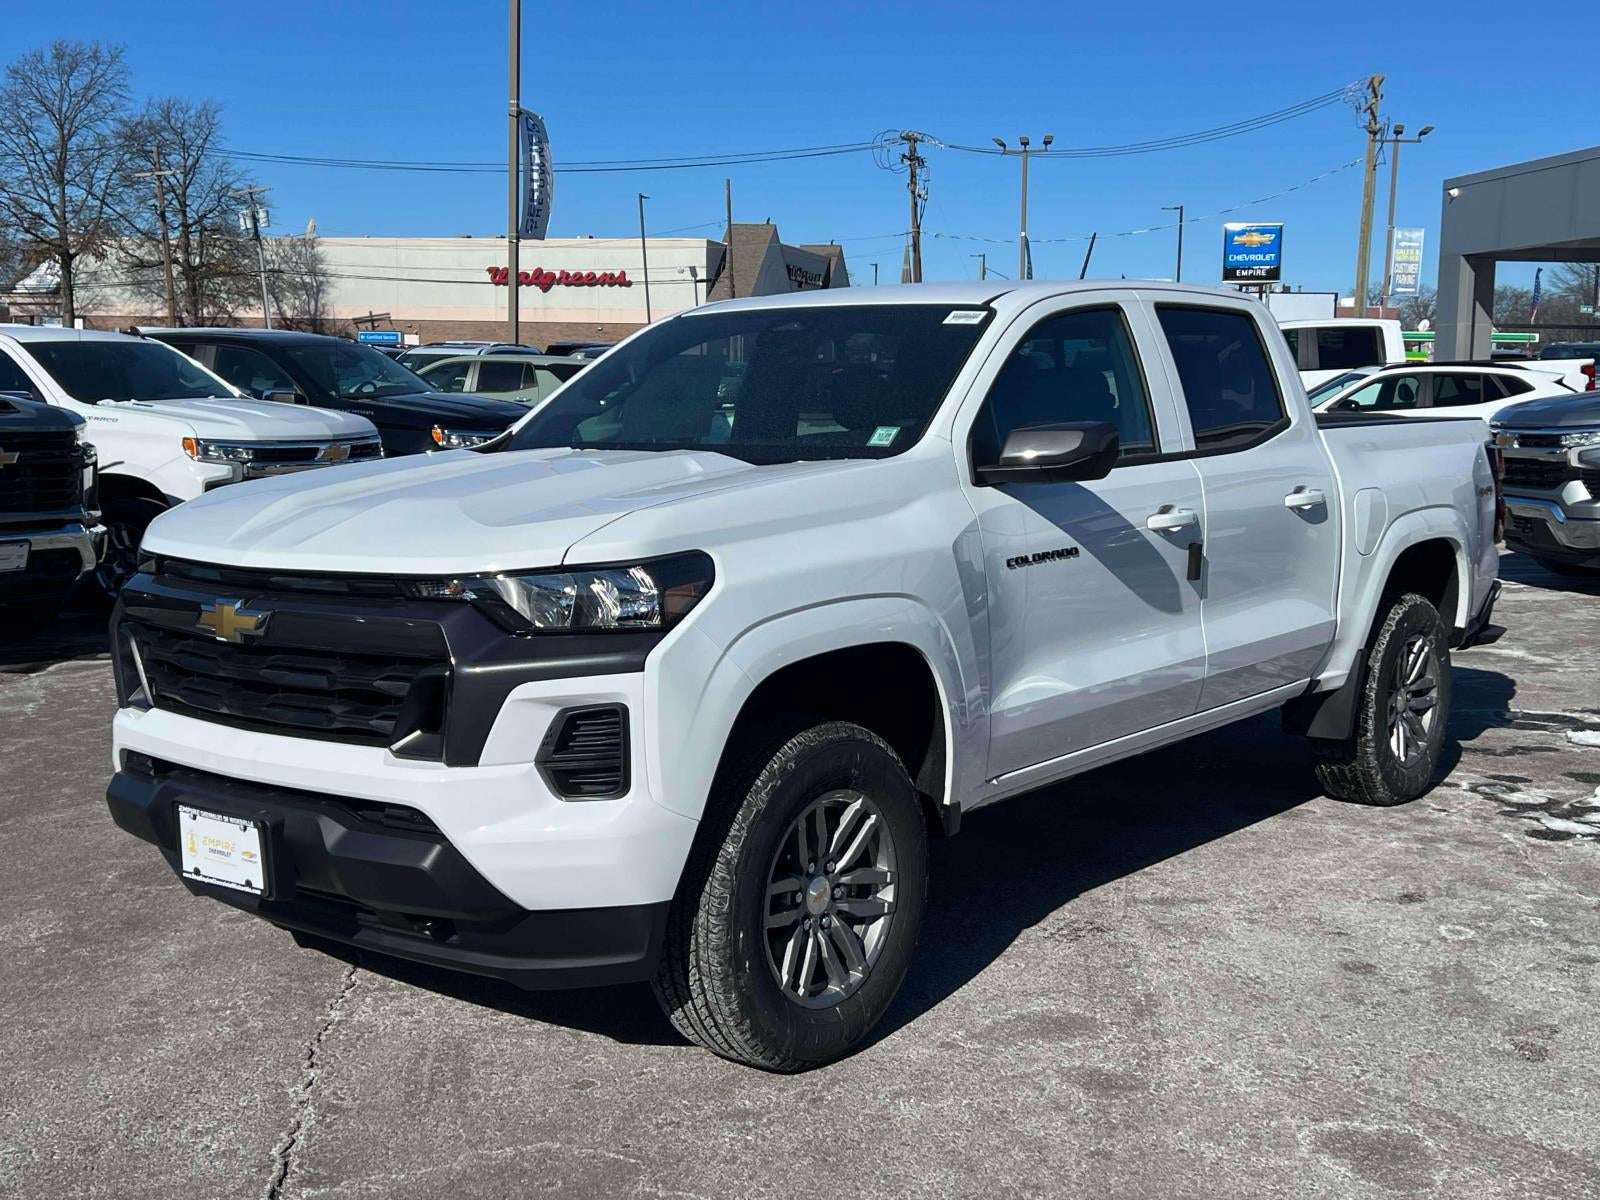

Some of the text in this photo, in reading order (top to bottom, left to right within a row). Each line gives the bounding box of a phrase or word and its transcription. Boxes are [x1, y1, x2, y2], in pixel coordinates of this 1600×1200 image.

[1394, 263, 1418, 273] CUSTOMER
[486, 266, 633, 293] Walgreens
[1395, 274, 1416, 284] PARKING
[1006, 547, 1080, 570] COLORADO
[202, 836, 237, 853] EMPIRE
